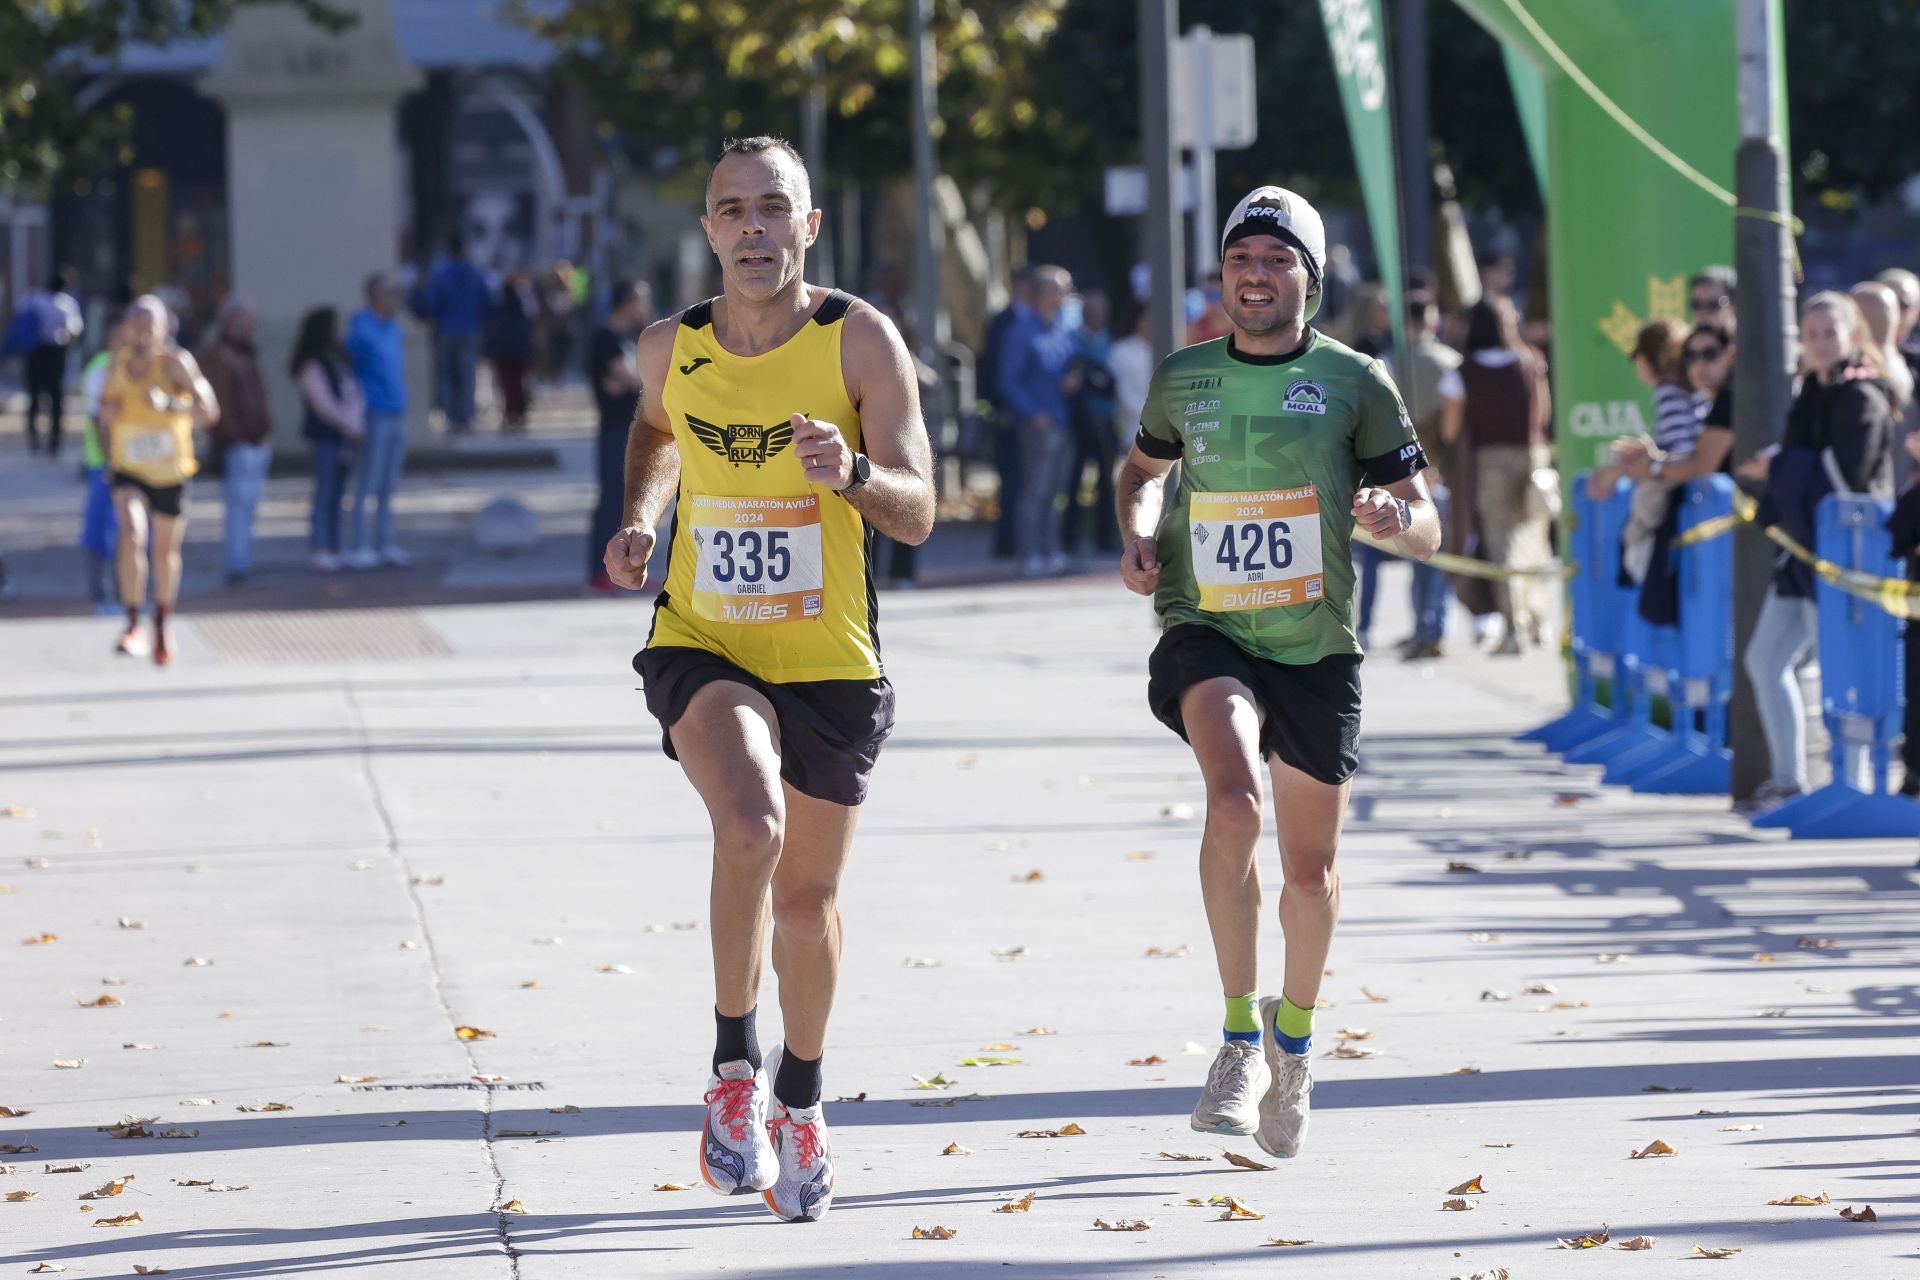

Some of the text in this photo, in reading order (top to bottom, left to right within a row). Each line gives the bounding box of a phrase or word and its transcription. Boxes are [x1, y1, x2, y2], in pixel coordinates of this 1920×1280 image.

[1287, 402, 1321, 413] MOAL
[731, 427, 761, 438] BORN
[1215, 495, 1239, 503] MEDIA
[1240, 490, 1284, 503] MARATÓN
[1284, 488, 1314, 501] AVILÉS
[713, 500, 736, 509] MEDIA
[739, 498, 784, 509] MARATÓN
[785, 496, 816, 509] AVILÉS
[1236, 507, 1265, 517] 2024
[734, 513, 764, 523] 2024
[1216, 521, 1293, 572] 426
[712, 530, 791, 583] 335
[1247, 571, 1264, 582] ADRI
[737, 583, 767, 594] GABRIEL
[1222, 587, 1293, 608] avilés
